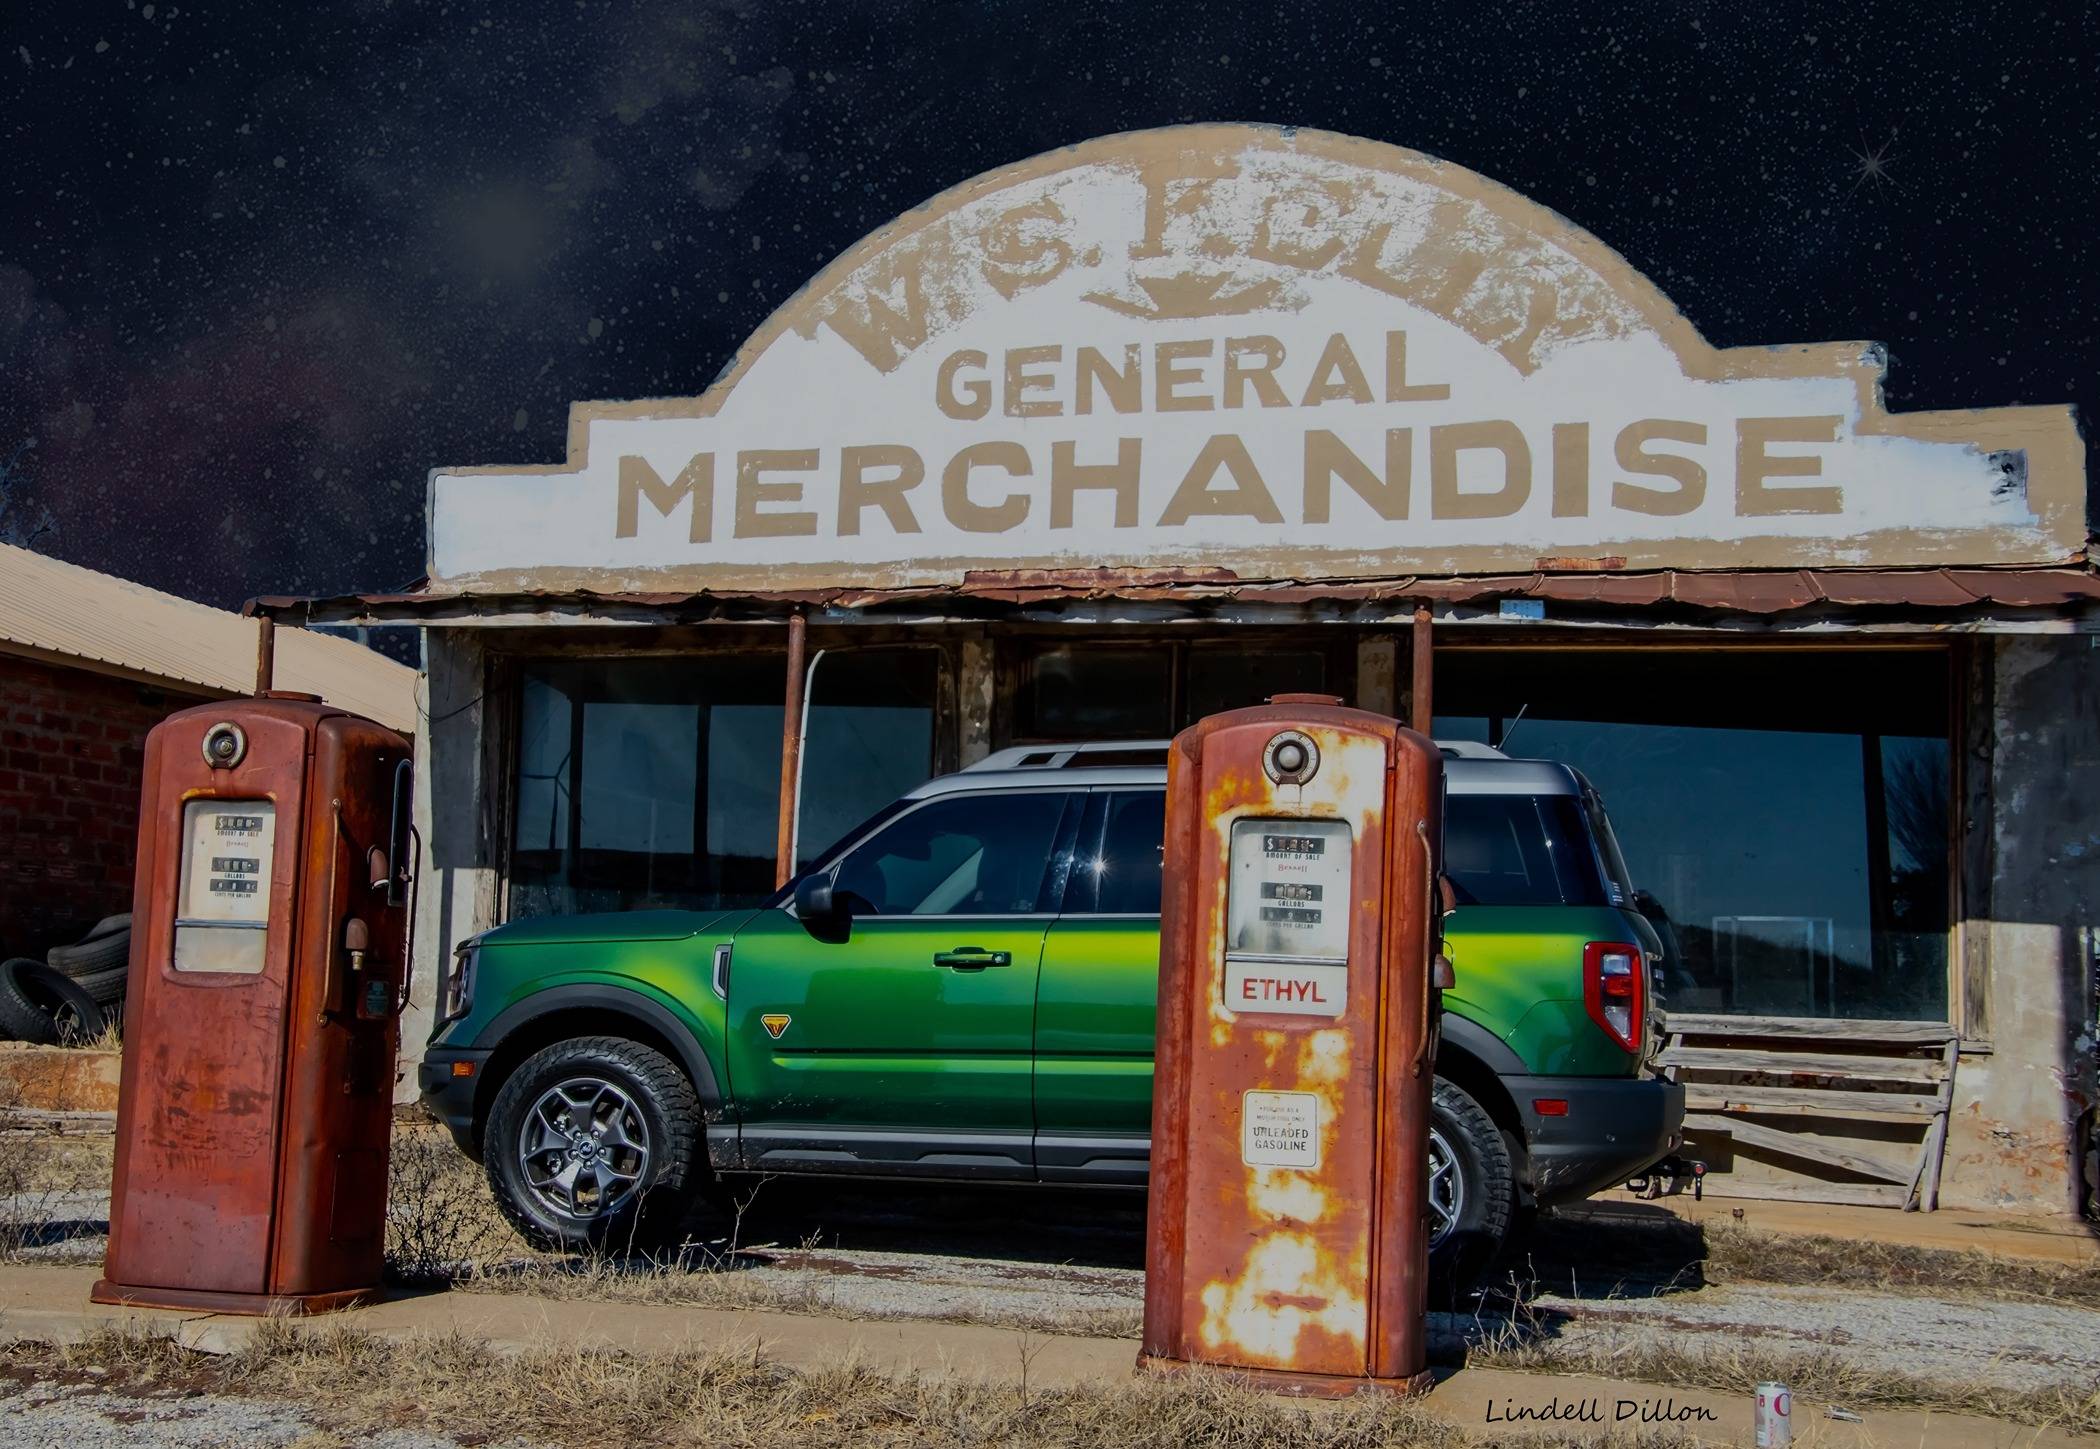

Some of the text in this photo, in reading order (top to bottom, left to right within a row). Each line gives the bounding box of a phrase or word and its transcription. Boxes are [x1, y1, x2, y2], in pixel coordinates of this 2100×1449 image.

[936, 330, 1450, 420] GENERAL
[615, 415, 1844, 544] MERCHANDISE
[1242, 978, 1327, 1003] ETHYL
[1253, 1127, 1309, 1139] UNLEADED
[1256, 1140, 1306, 1152] GASOLINE
